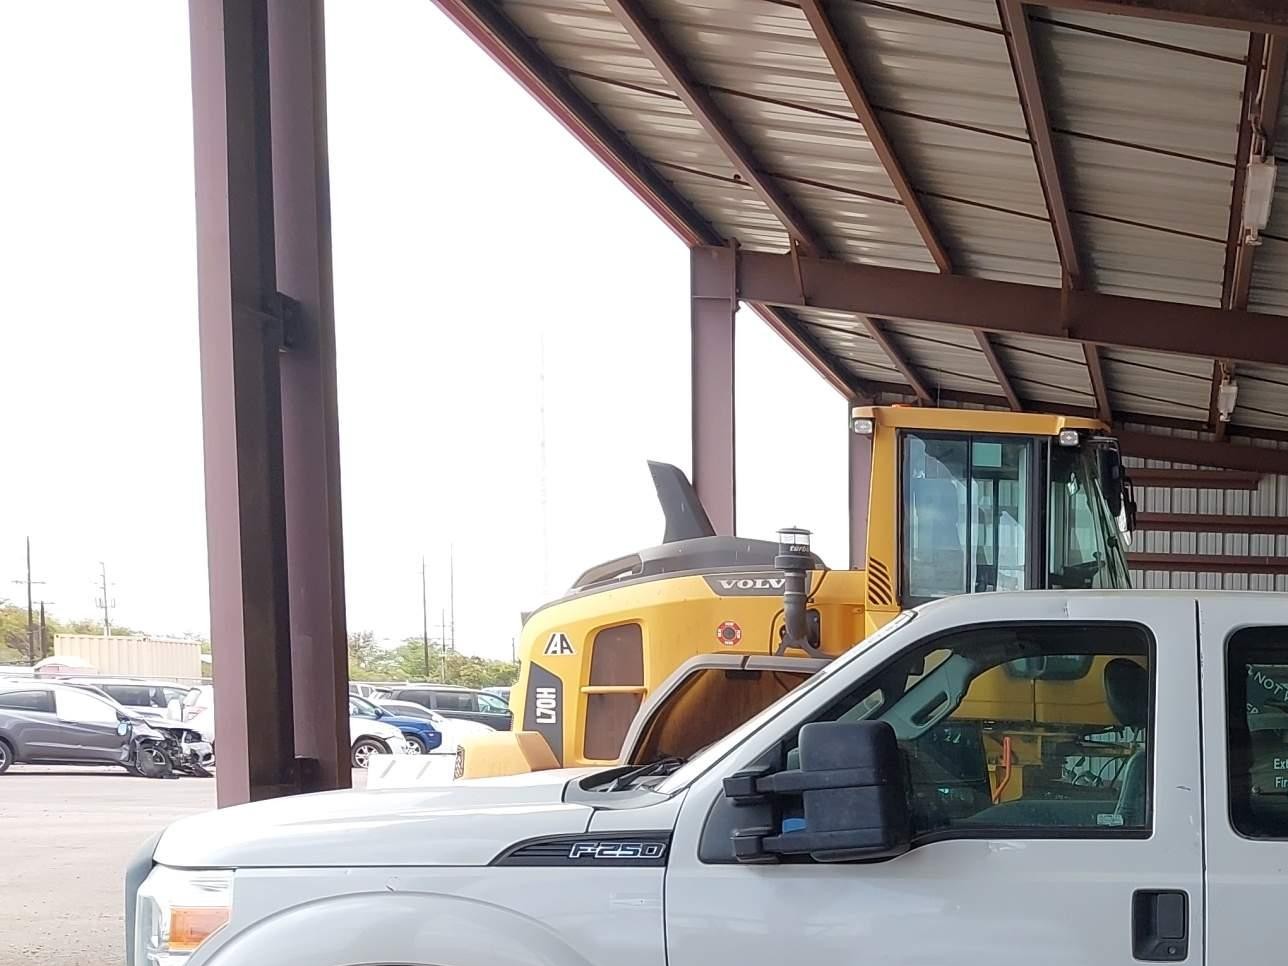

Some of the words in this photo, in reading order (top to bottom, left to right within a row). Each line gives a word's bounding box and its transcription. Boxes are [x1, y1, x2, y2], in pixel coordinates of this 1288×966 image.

[719, 579, 786, 589] VOLV
[1254, 671, 1284, 695] NOT
[535, 687, 557, 724] L70H
[568, 842, 666, 858] F-250
